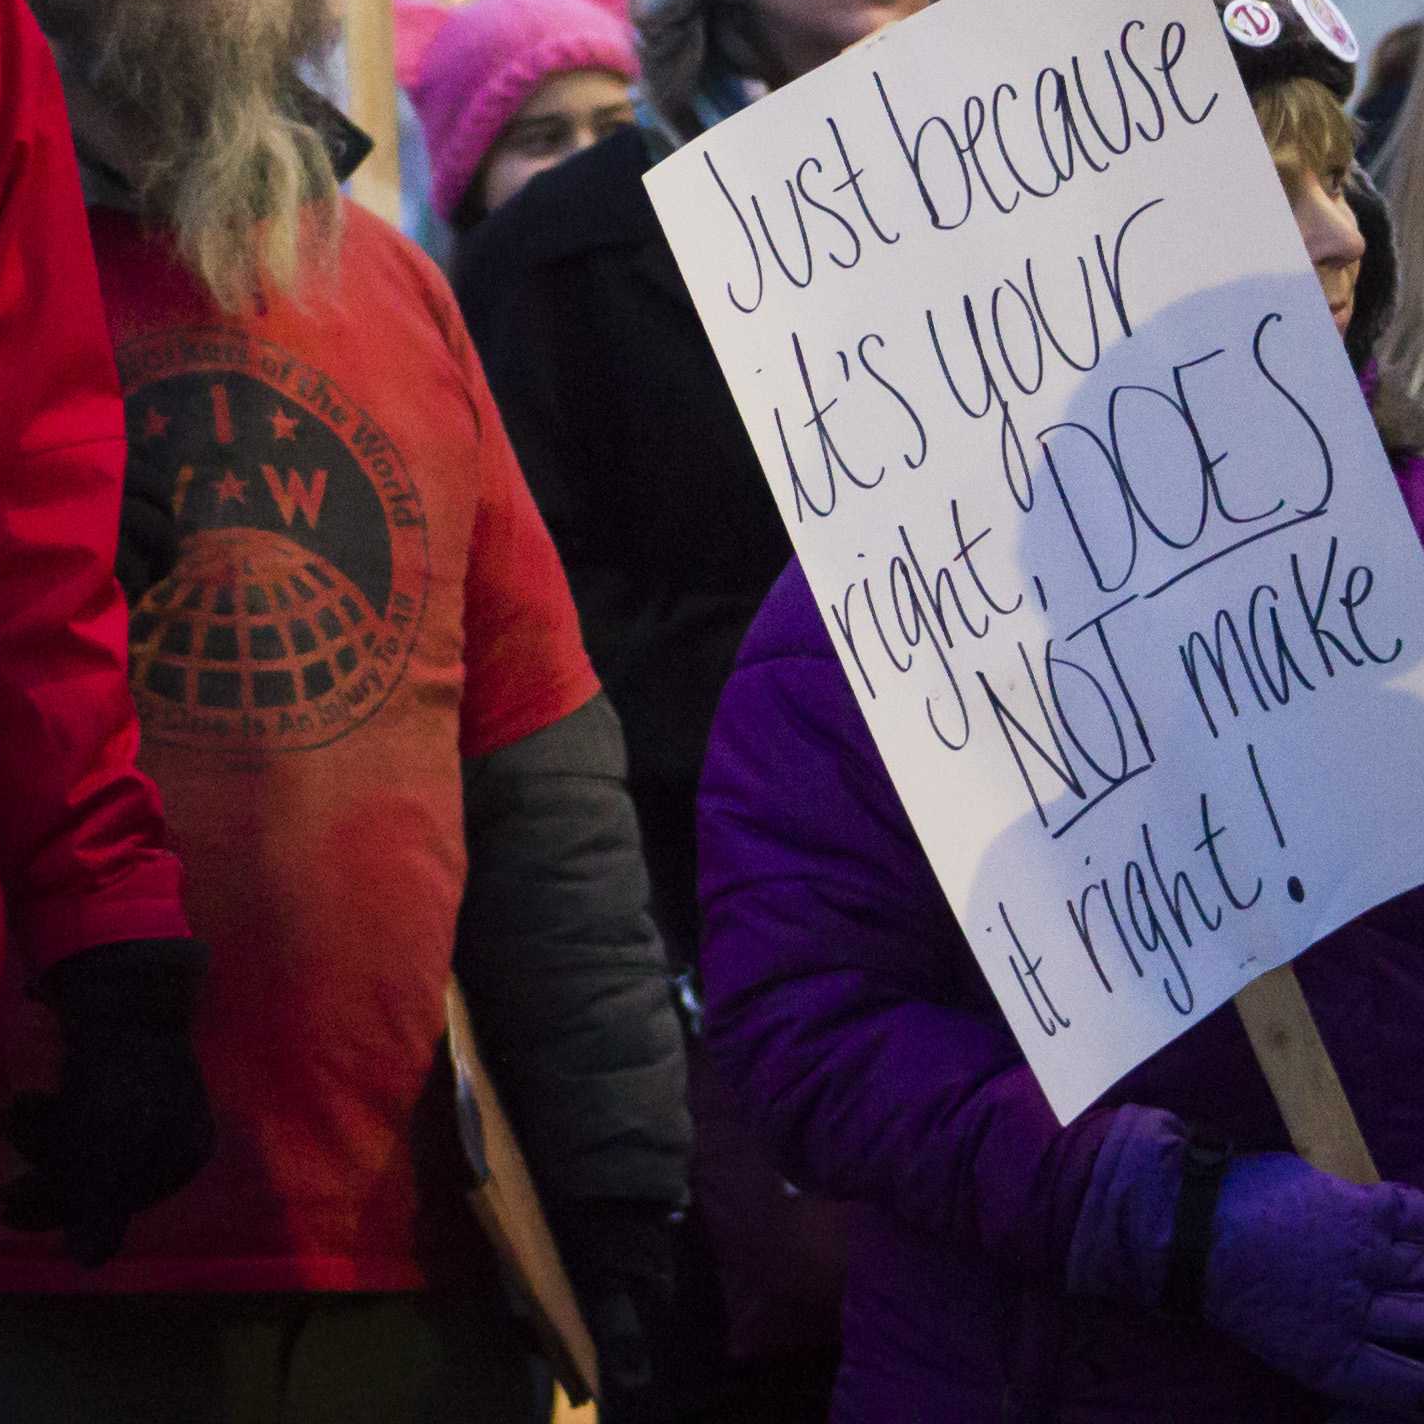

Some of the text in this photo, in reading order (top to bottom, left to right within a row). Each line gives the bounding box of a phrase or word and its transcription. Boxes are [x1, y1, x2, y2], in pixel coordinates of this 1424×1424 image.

[703, 19, 1219, 316] Just because
[209, 383, 232, 444] I
[262, 465, 328, 529] W
[754, 198, 1166, 526] it's your
[1039, 312, 1335, 595] DOES
[975, 537, 1404, 832] NOT make
[994, 899, 1072, 1039] it
